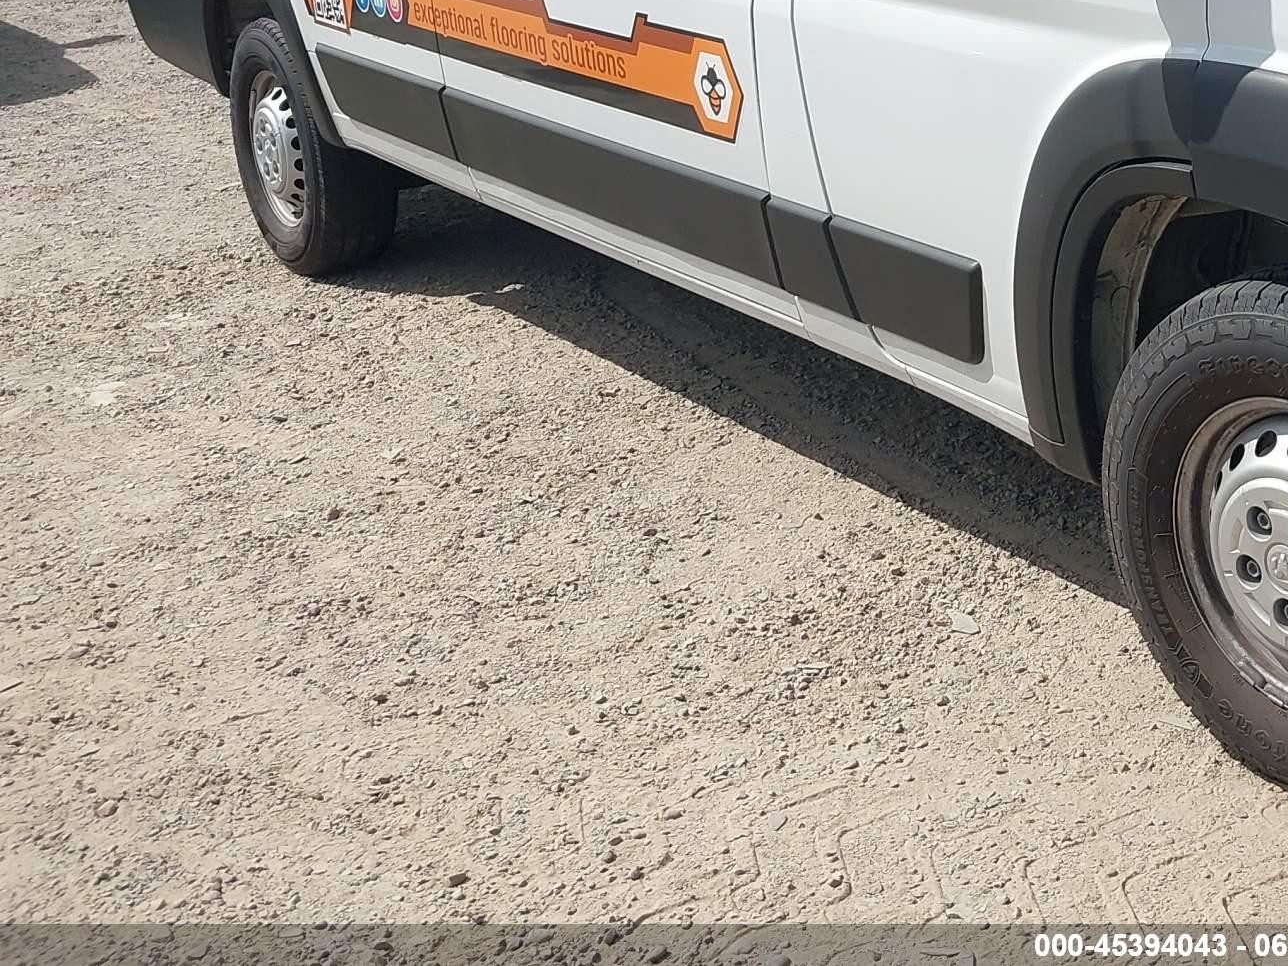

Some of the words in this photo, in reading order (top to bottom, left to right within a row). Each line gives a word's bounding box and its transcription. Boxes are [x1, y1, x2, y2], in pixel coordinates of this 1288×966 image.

[413, 0, 488, 42] exceptional
[489, 15, 548, 63] flooring
[552, 36, 627, 79] solutions
